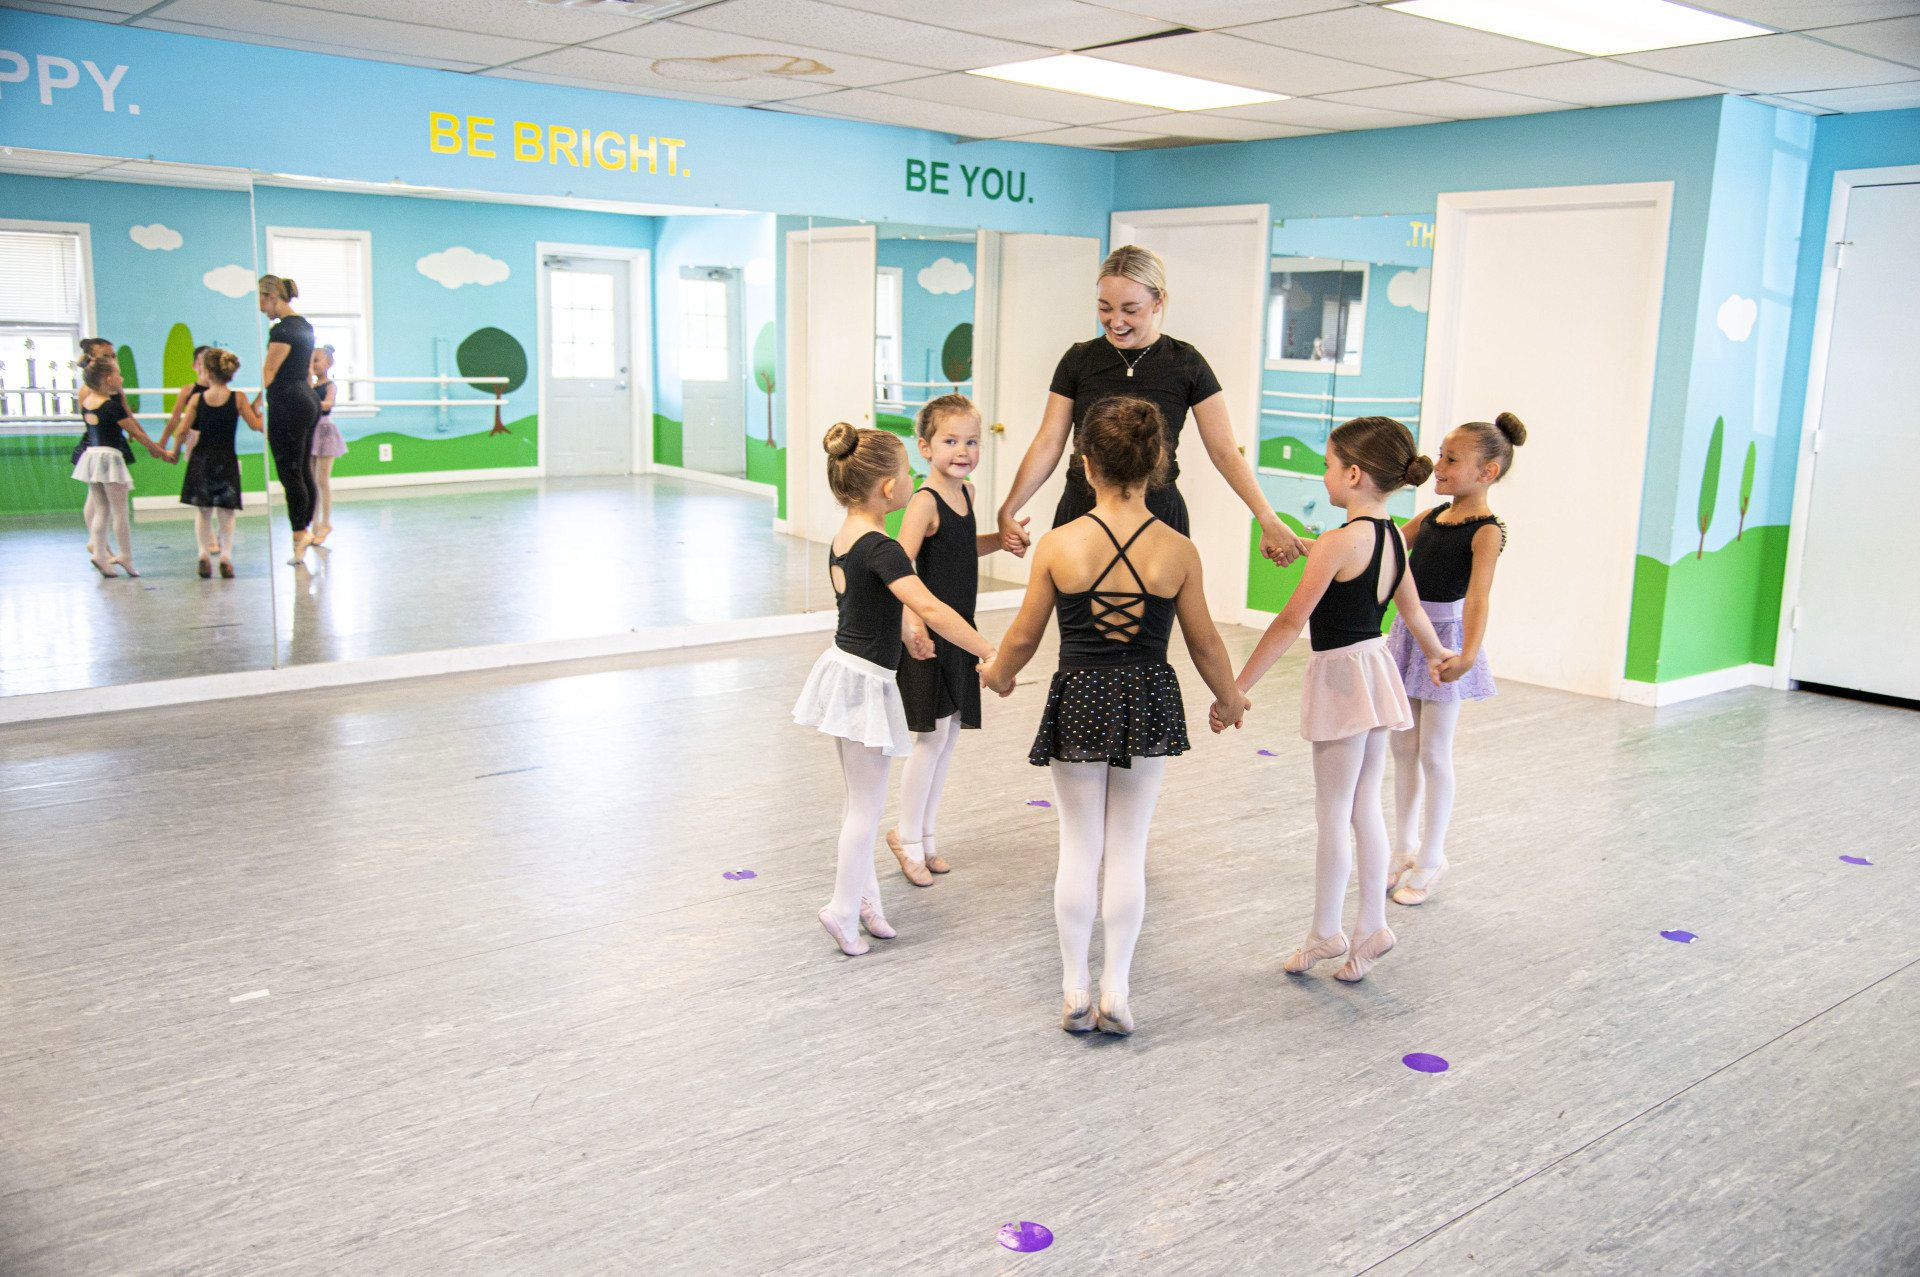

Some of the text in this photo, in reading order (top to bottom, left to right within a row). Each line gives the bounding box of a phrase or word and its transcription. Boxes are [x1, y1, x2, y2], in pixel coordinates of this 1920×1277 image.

[429, 111, 691, 177] BE BRIGHT.
[906, 158, 1033, 203] BE YOU.
